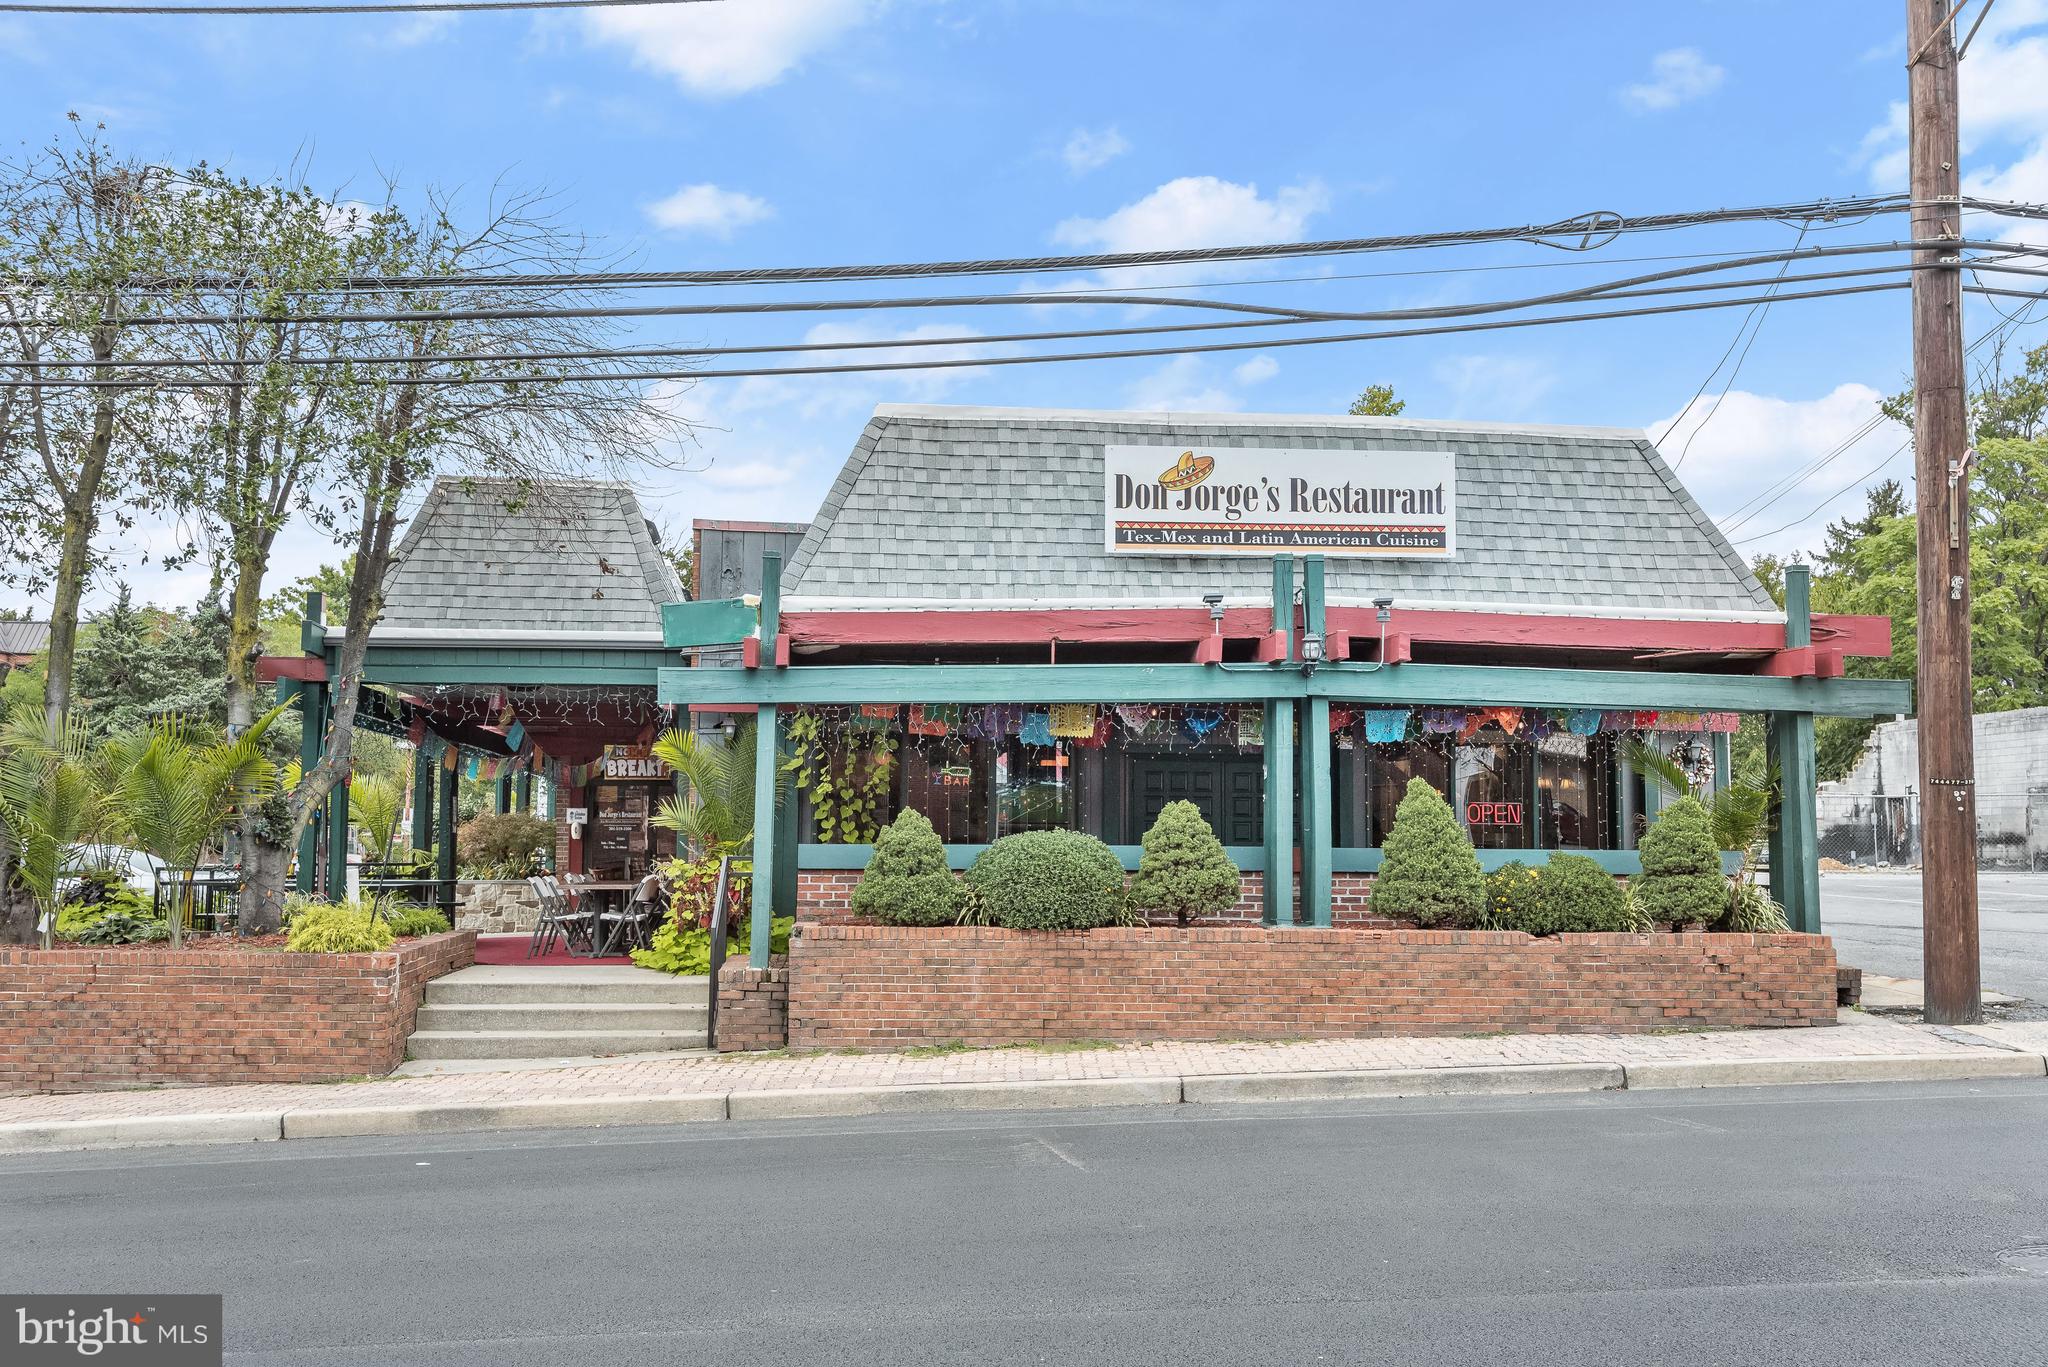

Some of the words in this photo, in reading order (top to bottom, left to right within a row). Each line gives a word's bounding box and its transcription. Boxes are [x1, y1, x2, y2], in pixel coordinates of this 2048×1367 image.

[1114, 474, 1168, 510] Don
[1176, 477, 1280, 520] Jorge's
[1289, 477, 1446, 515] Restaurant
[1123, 529, 1196, 544] Tex-Mex
[1202, 532, 1235, 545] and
[1240, 532, 1284, 546] Latin
[1290, 533, 1371, 547] American
[1376, 534, 1439, 547] Cuisine
[943, 774, 970, 786] BAR
[1467, 803, 1520, 823] OPEN
